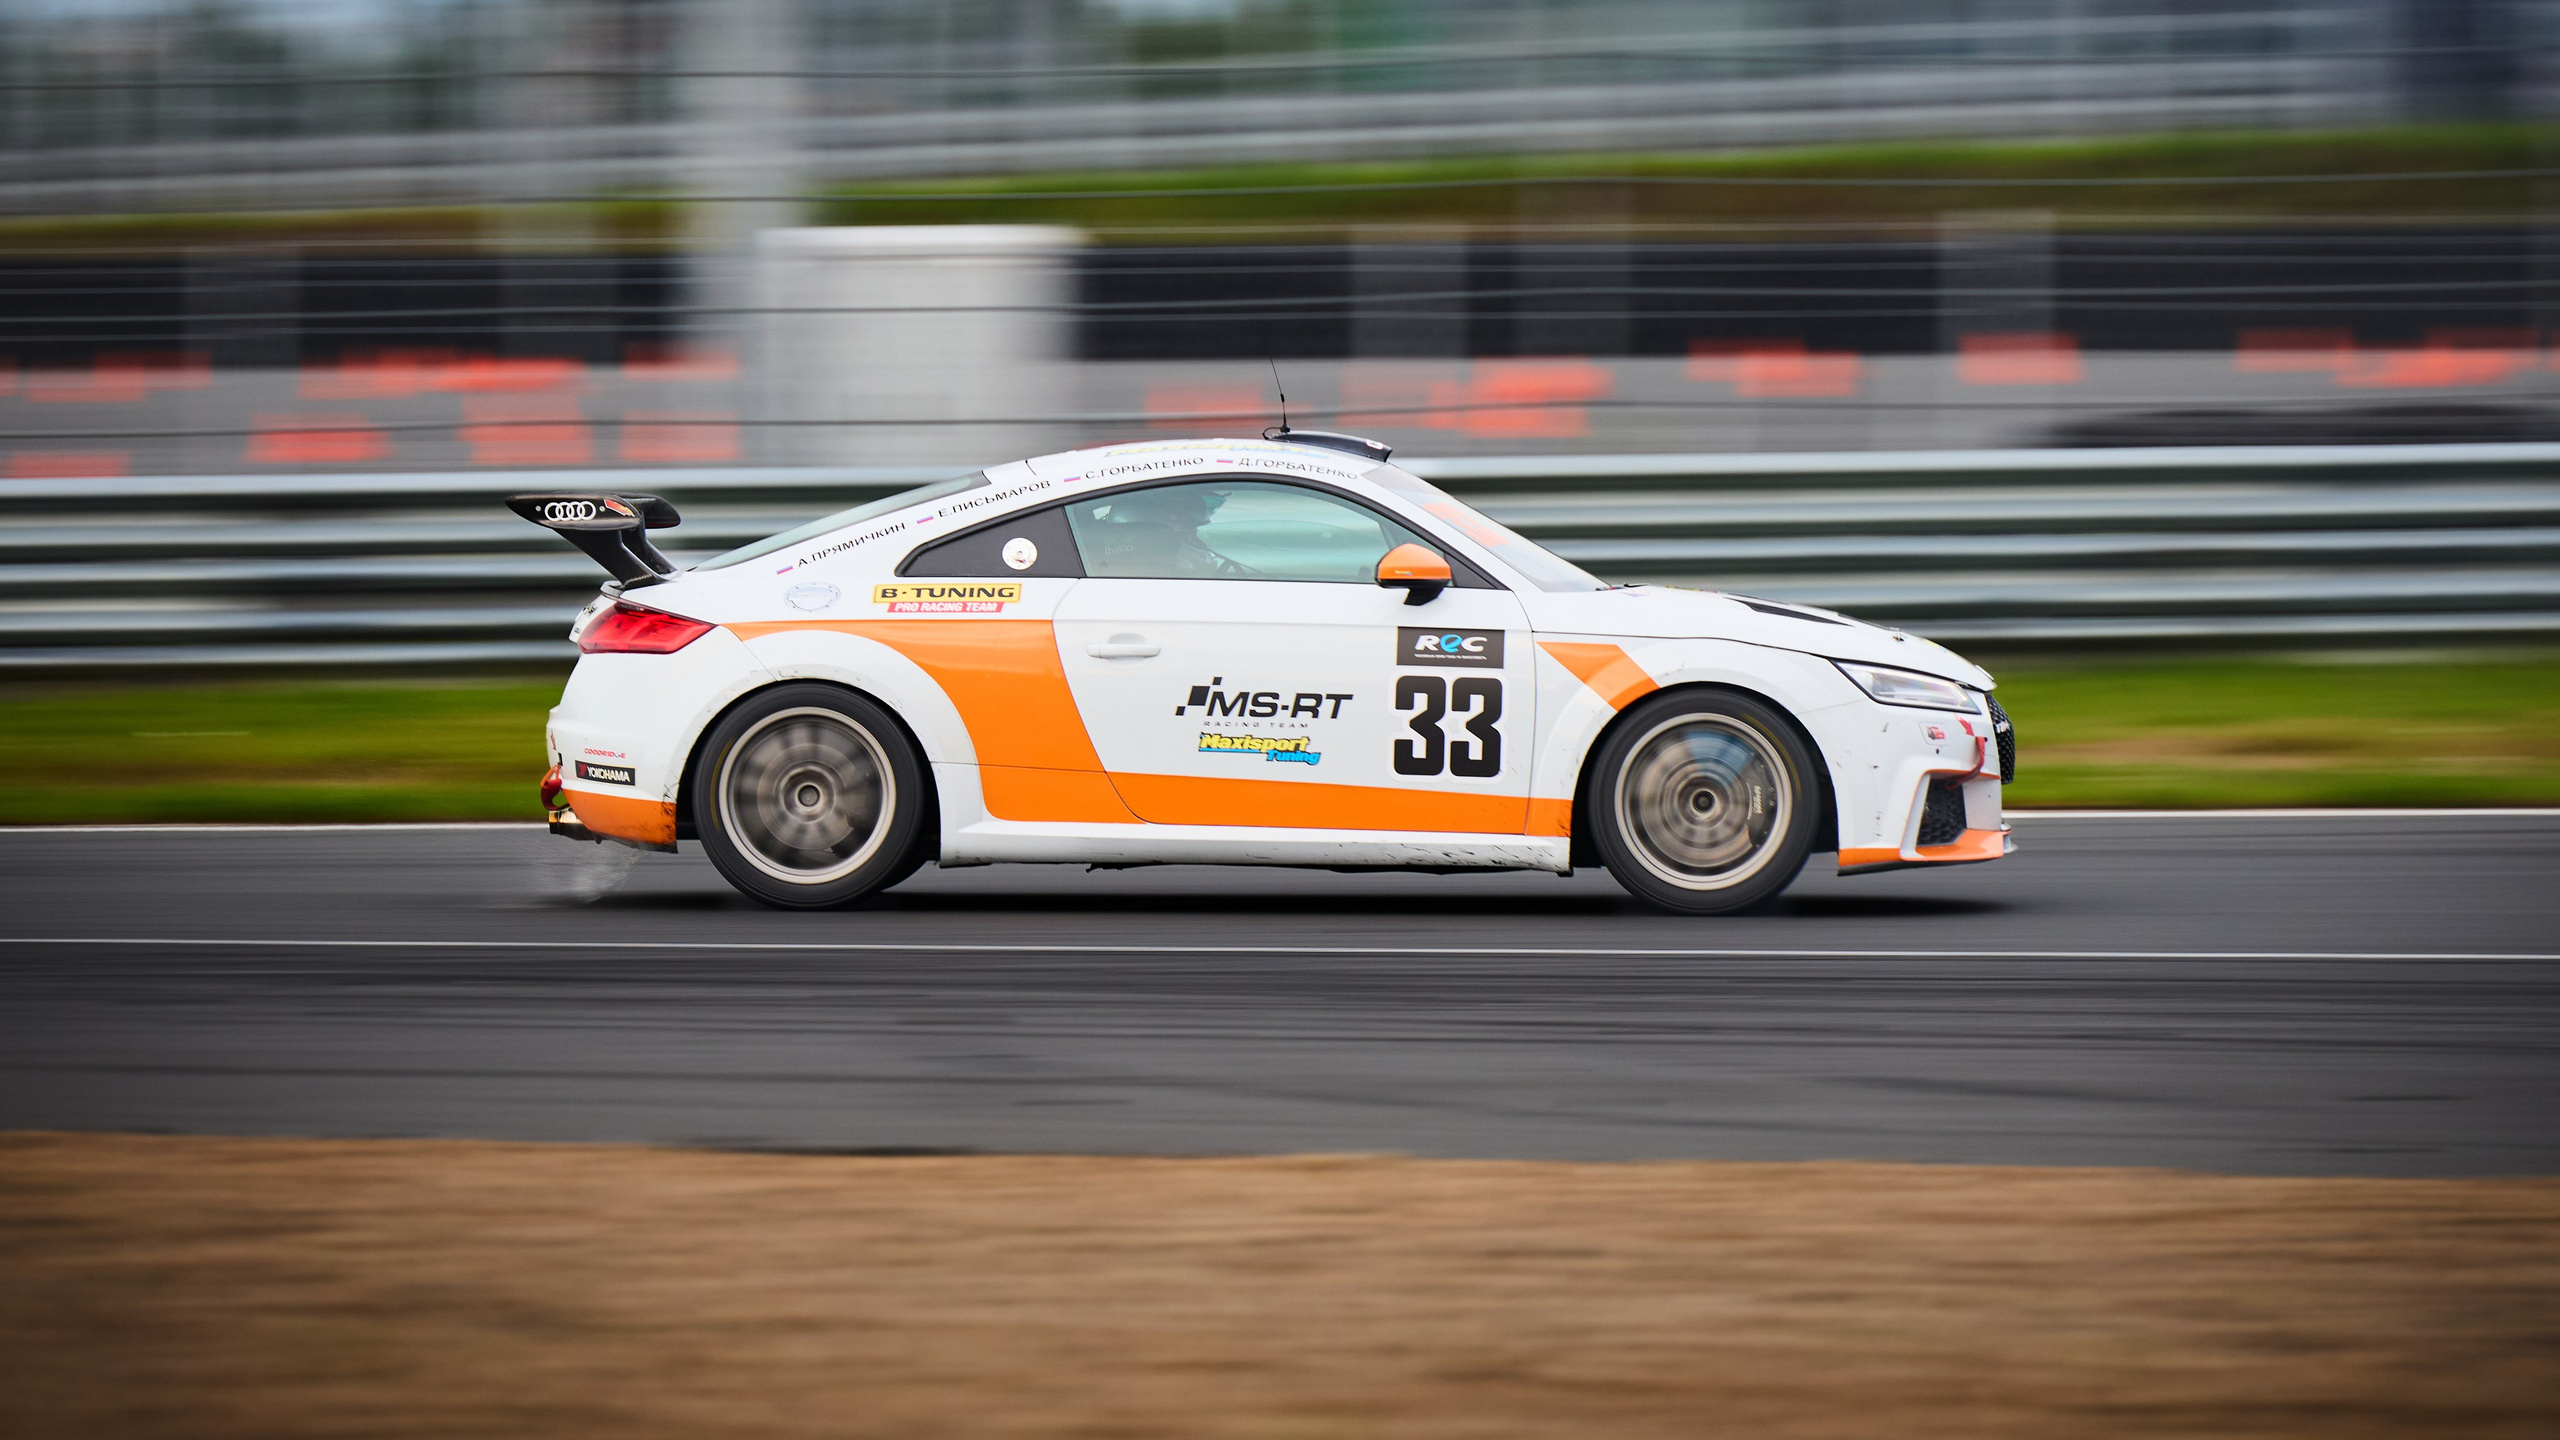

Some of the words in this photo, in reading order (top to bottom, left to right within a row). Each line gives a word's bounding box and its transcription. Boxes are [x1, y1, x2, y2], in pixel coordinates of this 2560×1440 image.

[1085, 456, 1205, 480] С.ГОРБАТЕНКО
[1238, 457, 1359, 481] Д.ГОРБАТЕНКО
[938, 480, 1051, 518] Е.ПИСЬМАРОВ
[798, 522, 907, 568] А.ПРЯМИЧКИН
[894, 602, 919, 612] PRO
[921, 602, 964, 612] RACING
[966, 602, 998, 612] TEAM
[1206, 691, 1354, 719] MS-RT
[1269, 721, 1309, 729] TEAM
[1393, 675, 1503, 777] 33
[1199, 732, 1311, 753] Maxisport
[1266, 750, 1322, 765] Tuning
[587, 766, 631, 782] YOKOHAMA
